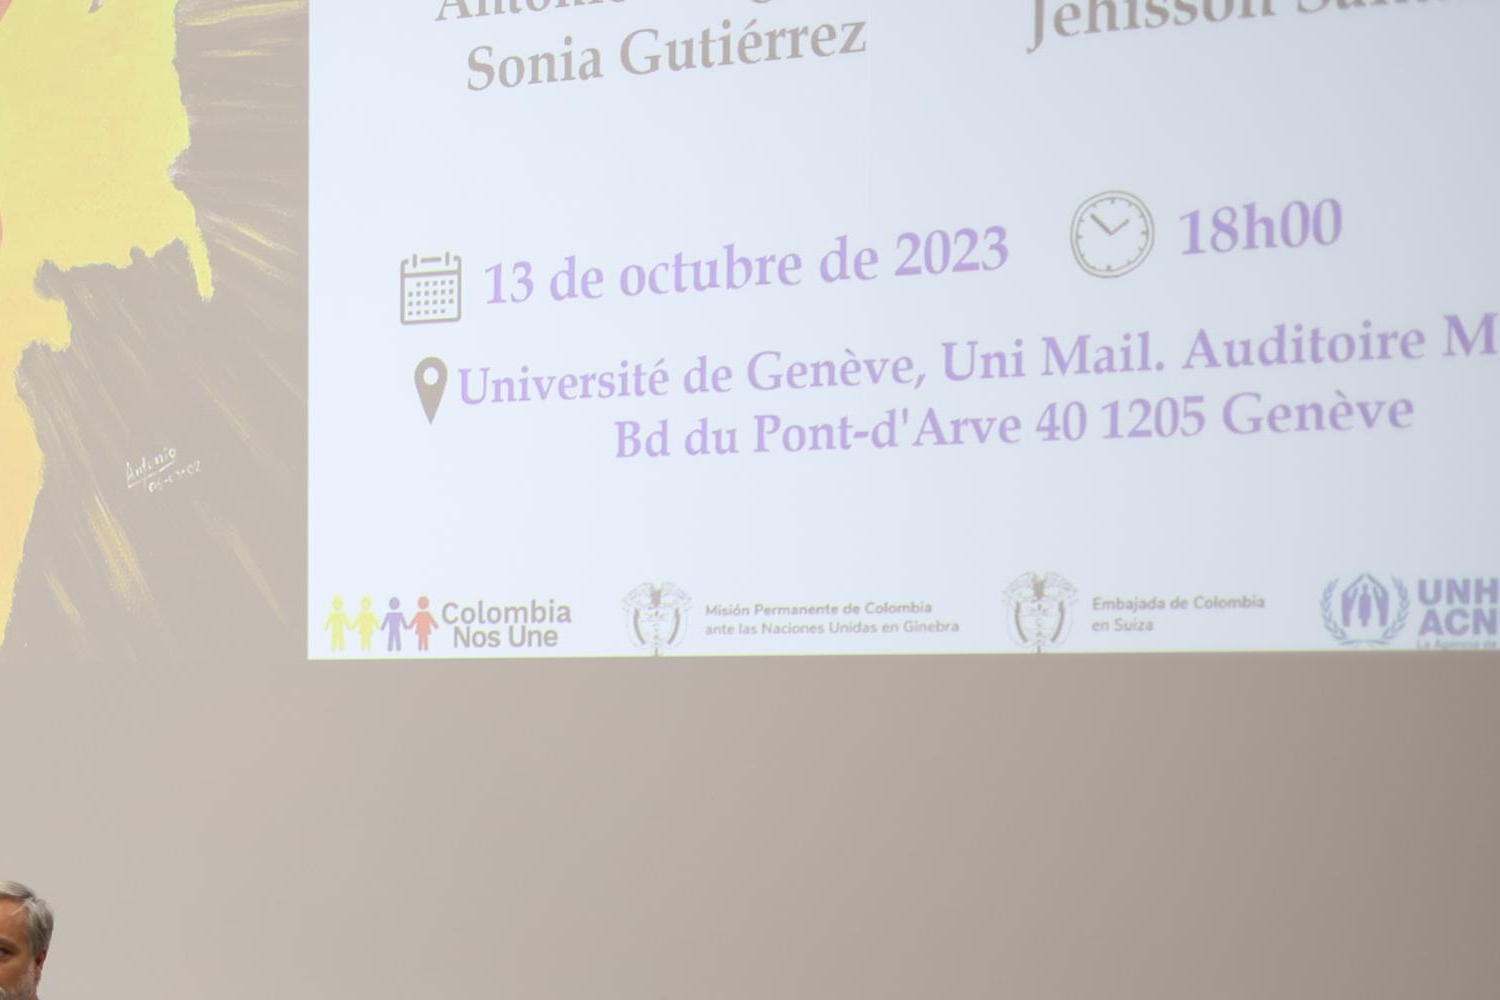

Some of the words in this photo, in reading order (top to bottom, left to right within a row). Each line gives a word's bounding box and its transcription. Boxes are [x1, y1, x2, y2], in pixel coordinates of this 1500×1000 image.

[468, 36, 604, 91] Sonia
[620, 19, 866, 75] Gutiérrez
[1180, 198, 1342, 255] 18h00
[485, 261, 534, 304] 13
[550, 255, 603, 301] de
[620, 243, 802, 296] octubre
[820, 235, 879, 283] de
[895, 225, 1008, 276] 2023
[458, 358, 669, 405] Université
[684, 355, 732, 394] de
[747, 348, 926, 391] Genève,
[941, 339, 1025, 381] Uni
[1041, 331, 1164, 376] Mail.
[1182, 320, 1425, 369] Auditoire
[614, 419, 670, 458] Bd
[685, 417, 739, 456] du
[753, 408, 1021, 453] Pont-d'Arve
[1036, 401, 1087, 441] 40
[1101, 395, 1205, 439] 1205
[1223, 390, 1413, 434] Genève
[1092, 596, 1165, 613] Embajada
[1170, 596, 1188, 610] de
[1193, 594, 1265, 610] Colombia
[1418, 577, 1499, 607] UNH
[441, 598, 572, 627] Colombia
[705, 603, 750, 617] Misión
[754, 603, 839, 616] Permanente
[843, 602, 860, 615] de
[864, 601, 932, 615] Colombia
[451, 623, 501, 648] Nos
[505, 622, 558, 648] Une
[705, 624, 735, 635] ante
[739, 623, 758, 635] las
[761, 621, 825, 634] Naciones
[828, 620, 878, 634] Unidas
[882, 623, 899, 633] en
[903, 619, 960, 633] Ginebra
[1091, 621, 1110, 632] en
[1114, 617, 1154, 632] Suiza
